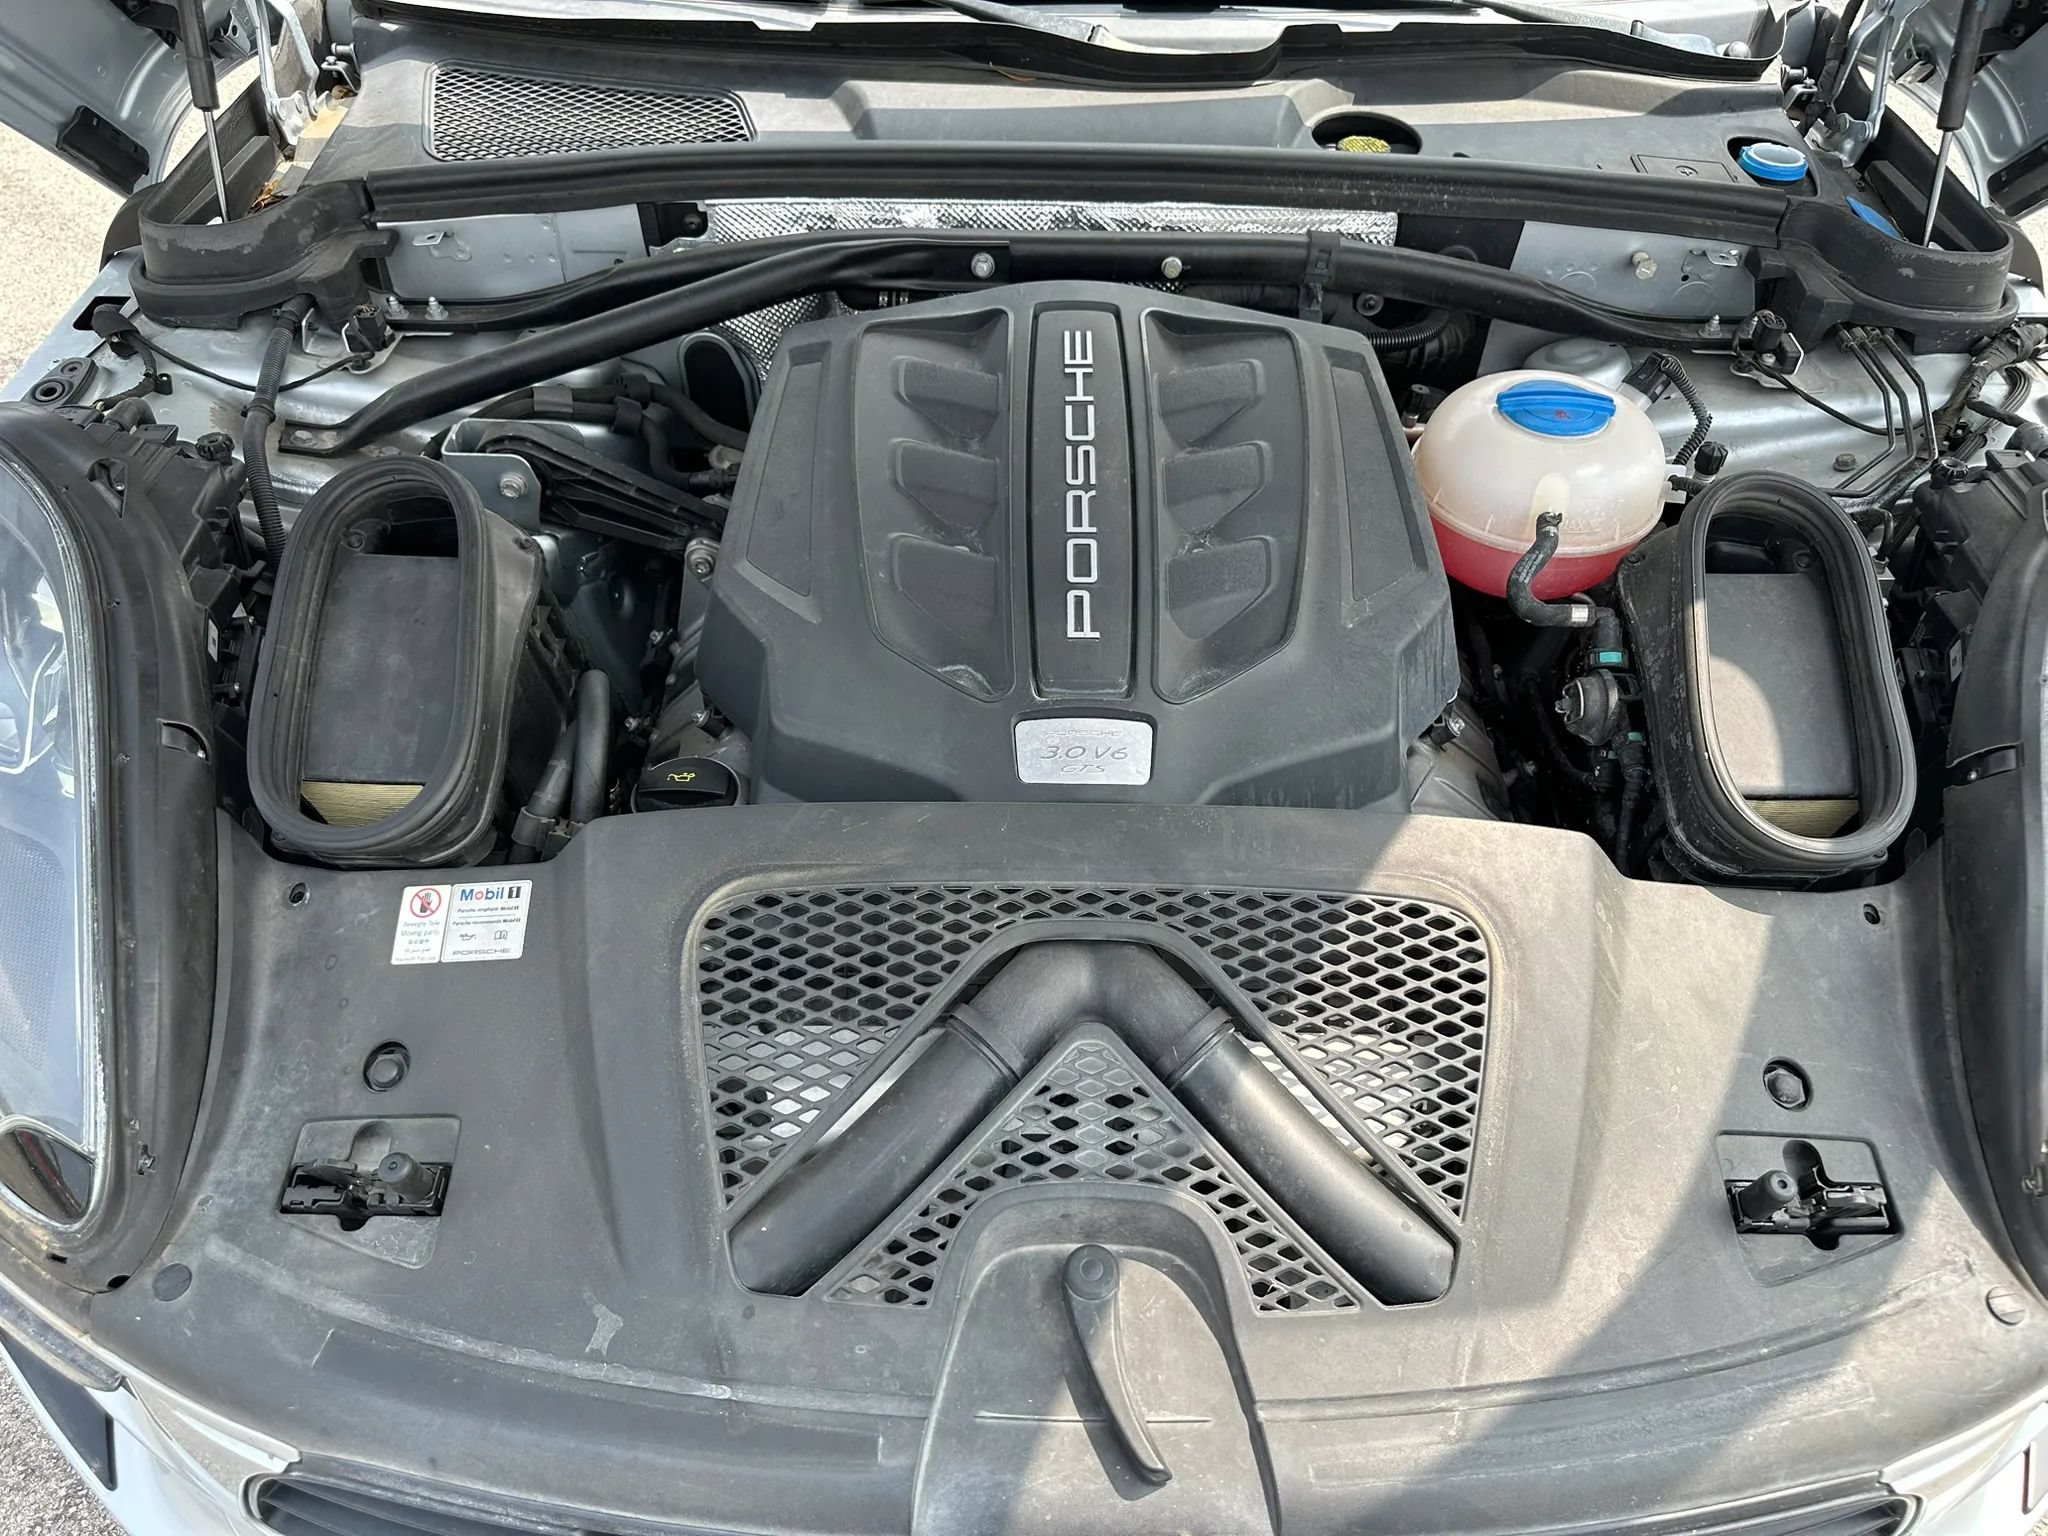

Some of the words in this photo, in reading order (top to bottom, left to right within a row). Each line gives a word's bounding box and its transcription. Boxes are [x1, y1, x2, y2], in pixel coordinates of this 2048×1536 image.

[1063, 330, 1101, 641] PORSCHE
[1040, 745, 1087, 760] 3.0
[1095, 746, 1129, 760] V6
[1061, 764, 1106, 774] GTS
[459, 886, 505, 901] Mobil
[507, 885, 522, 899] 1
[453, 947, 511, 956] PORSCHE
